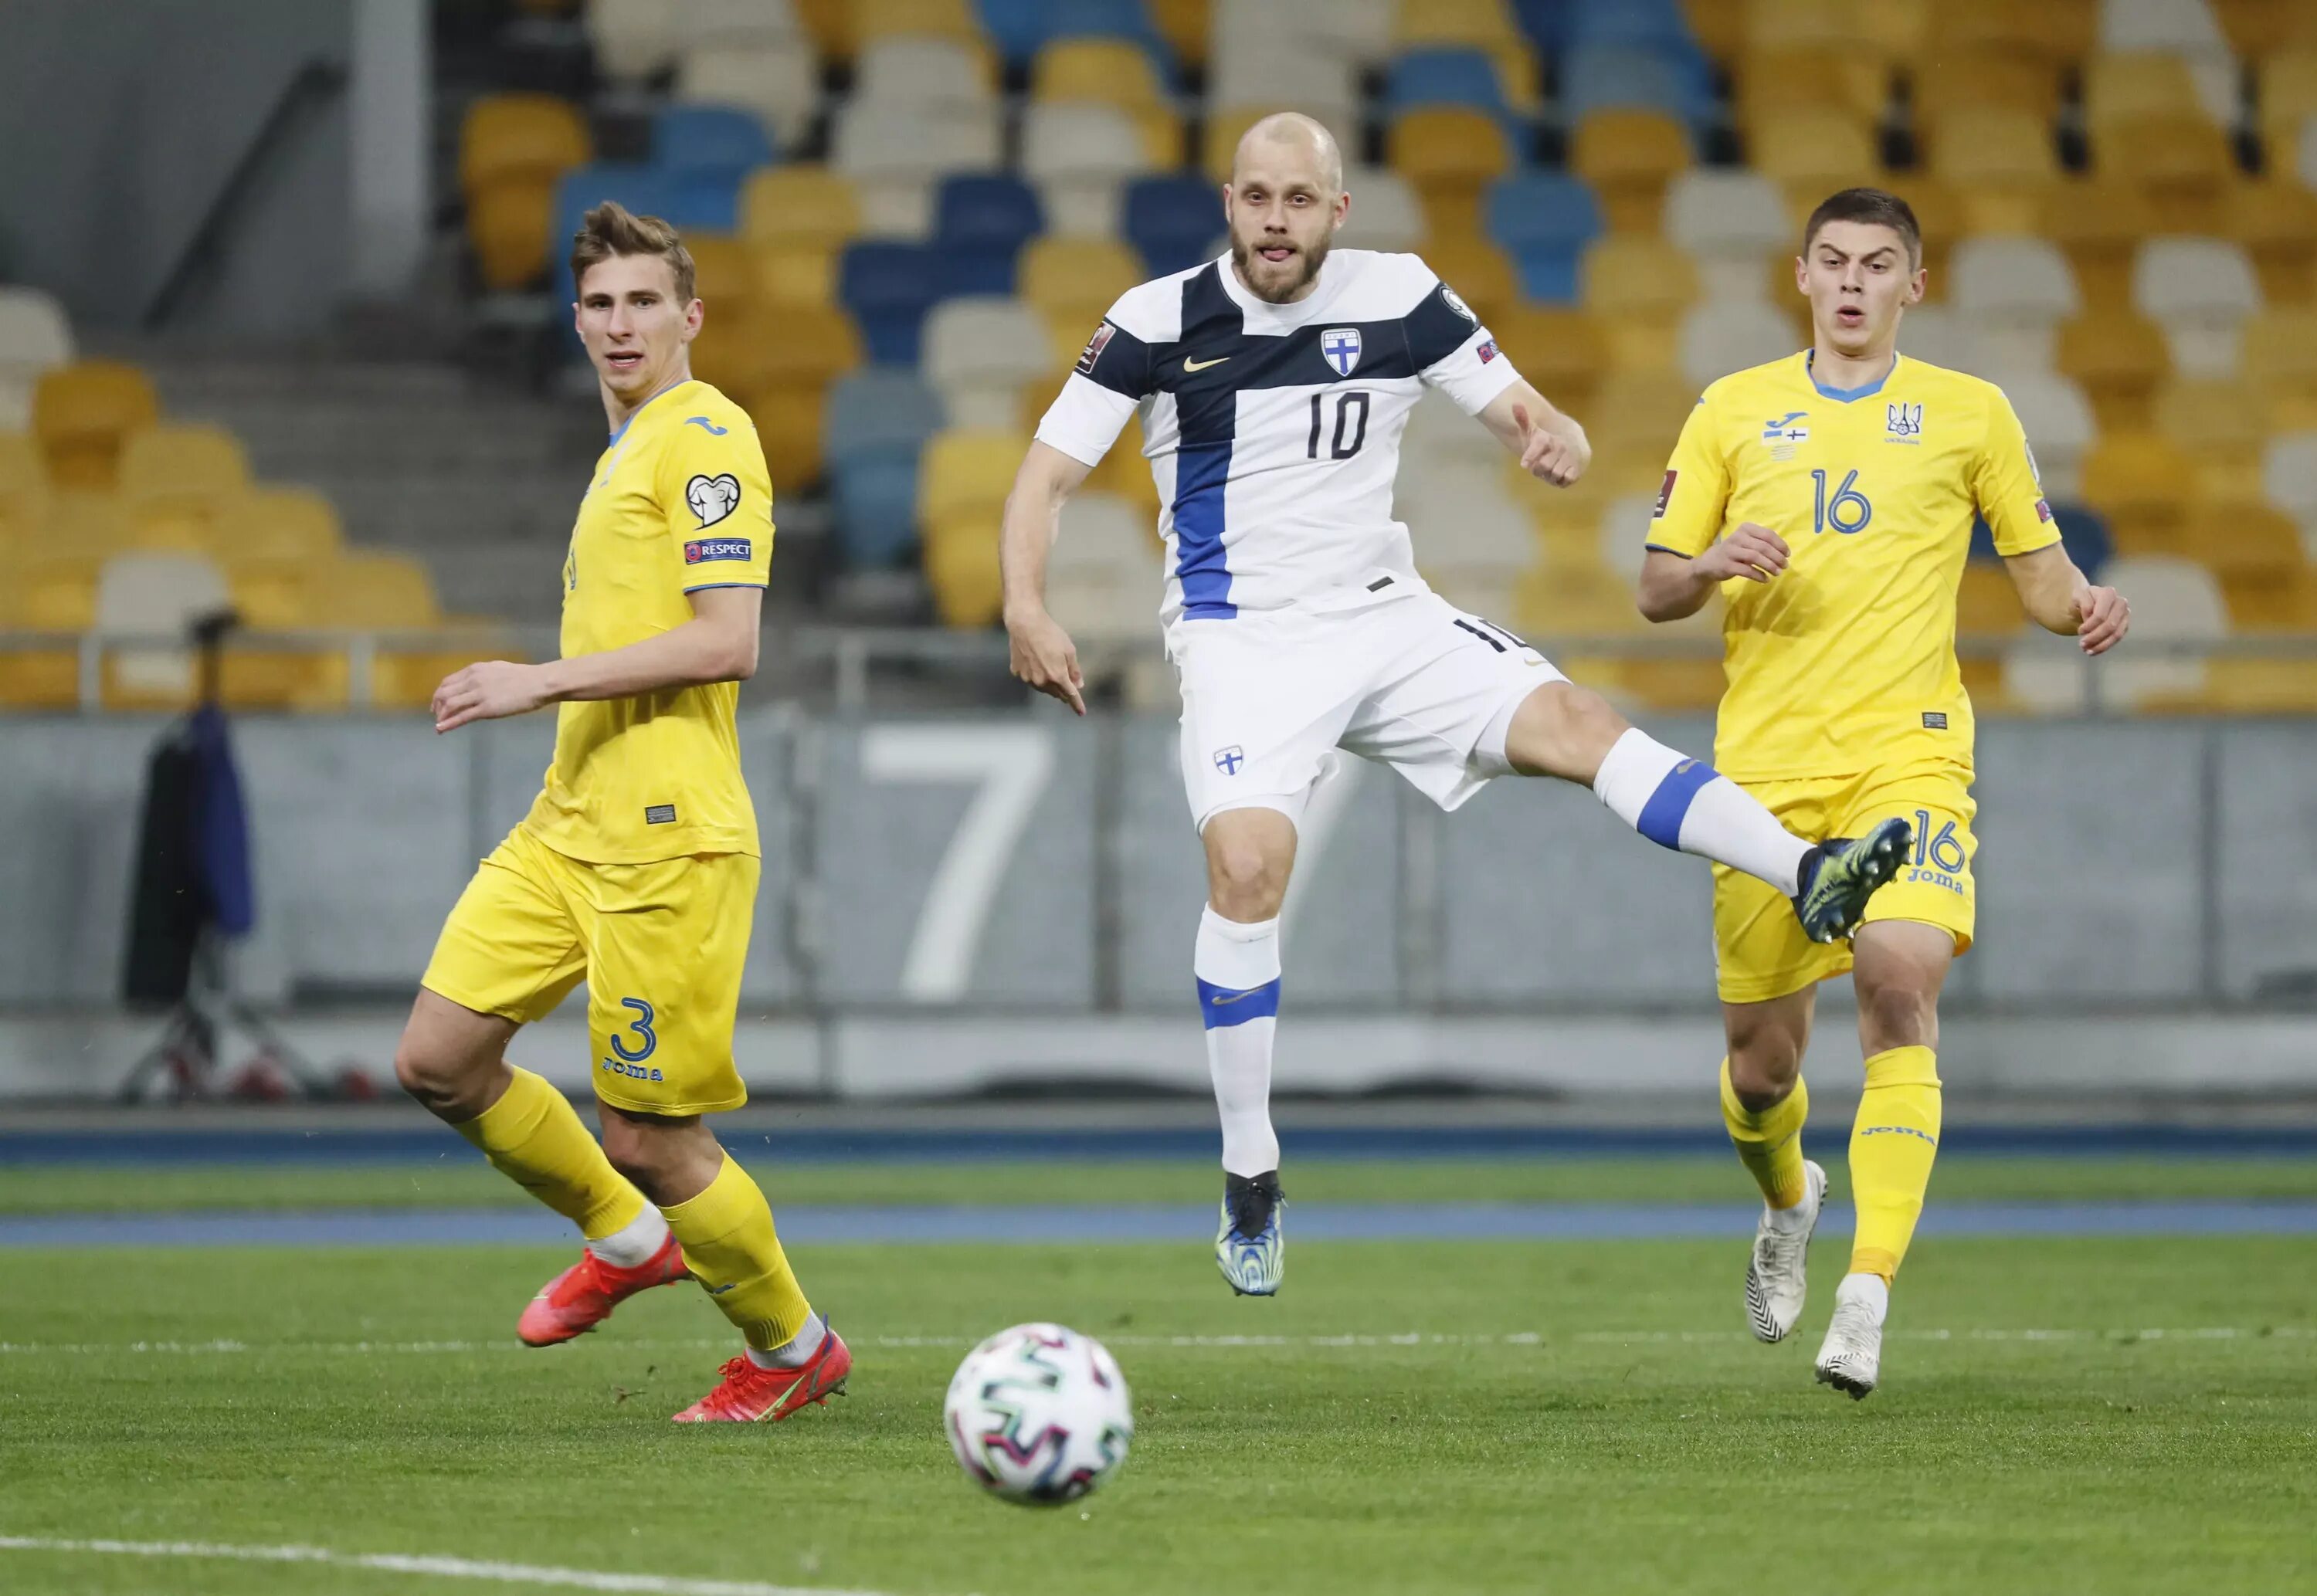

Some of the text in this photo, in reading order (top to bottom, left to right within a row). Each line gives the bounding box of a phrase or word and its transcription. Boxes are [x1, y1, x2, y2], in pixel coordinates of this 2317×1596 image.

[1307, 391, 1369, 459] 10
[1811, 469, 1871, 534] 16
[701, 544, 751, 555] RESPECT
[857, 732, 1052, 1002] 7
[1915, 809, 1965, 873] 16
[610, 997, 657, 1062] 3
